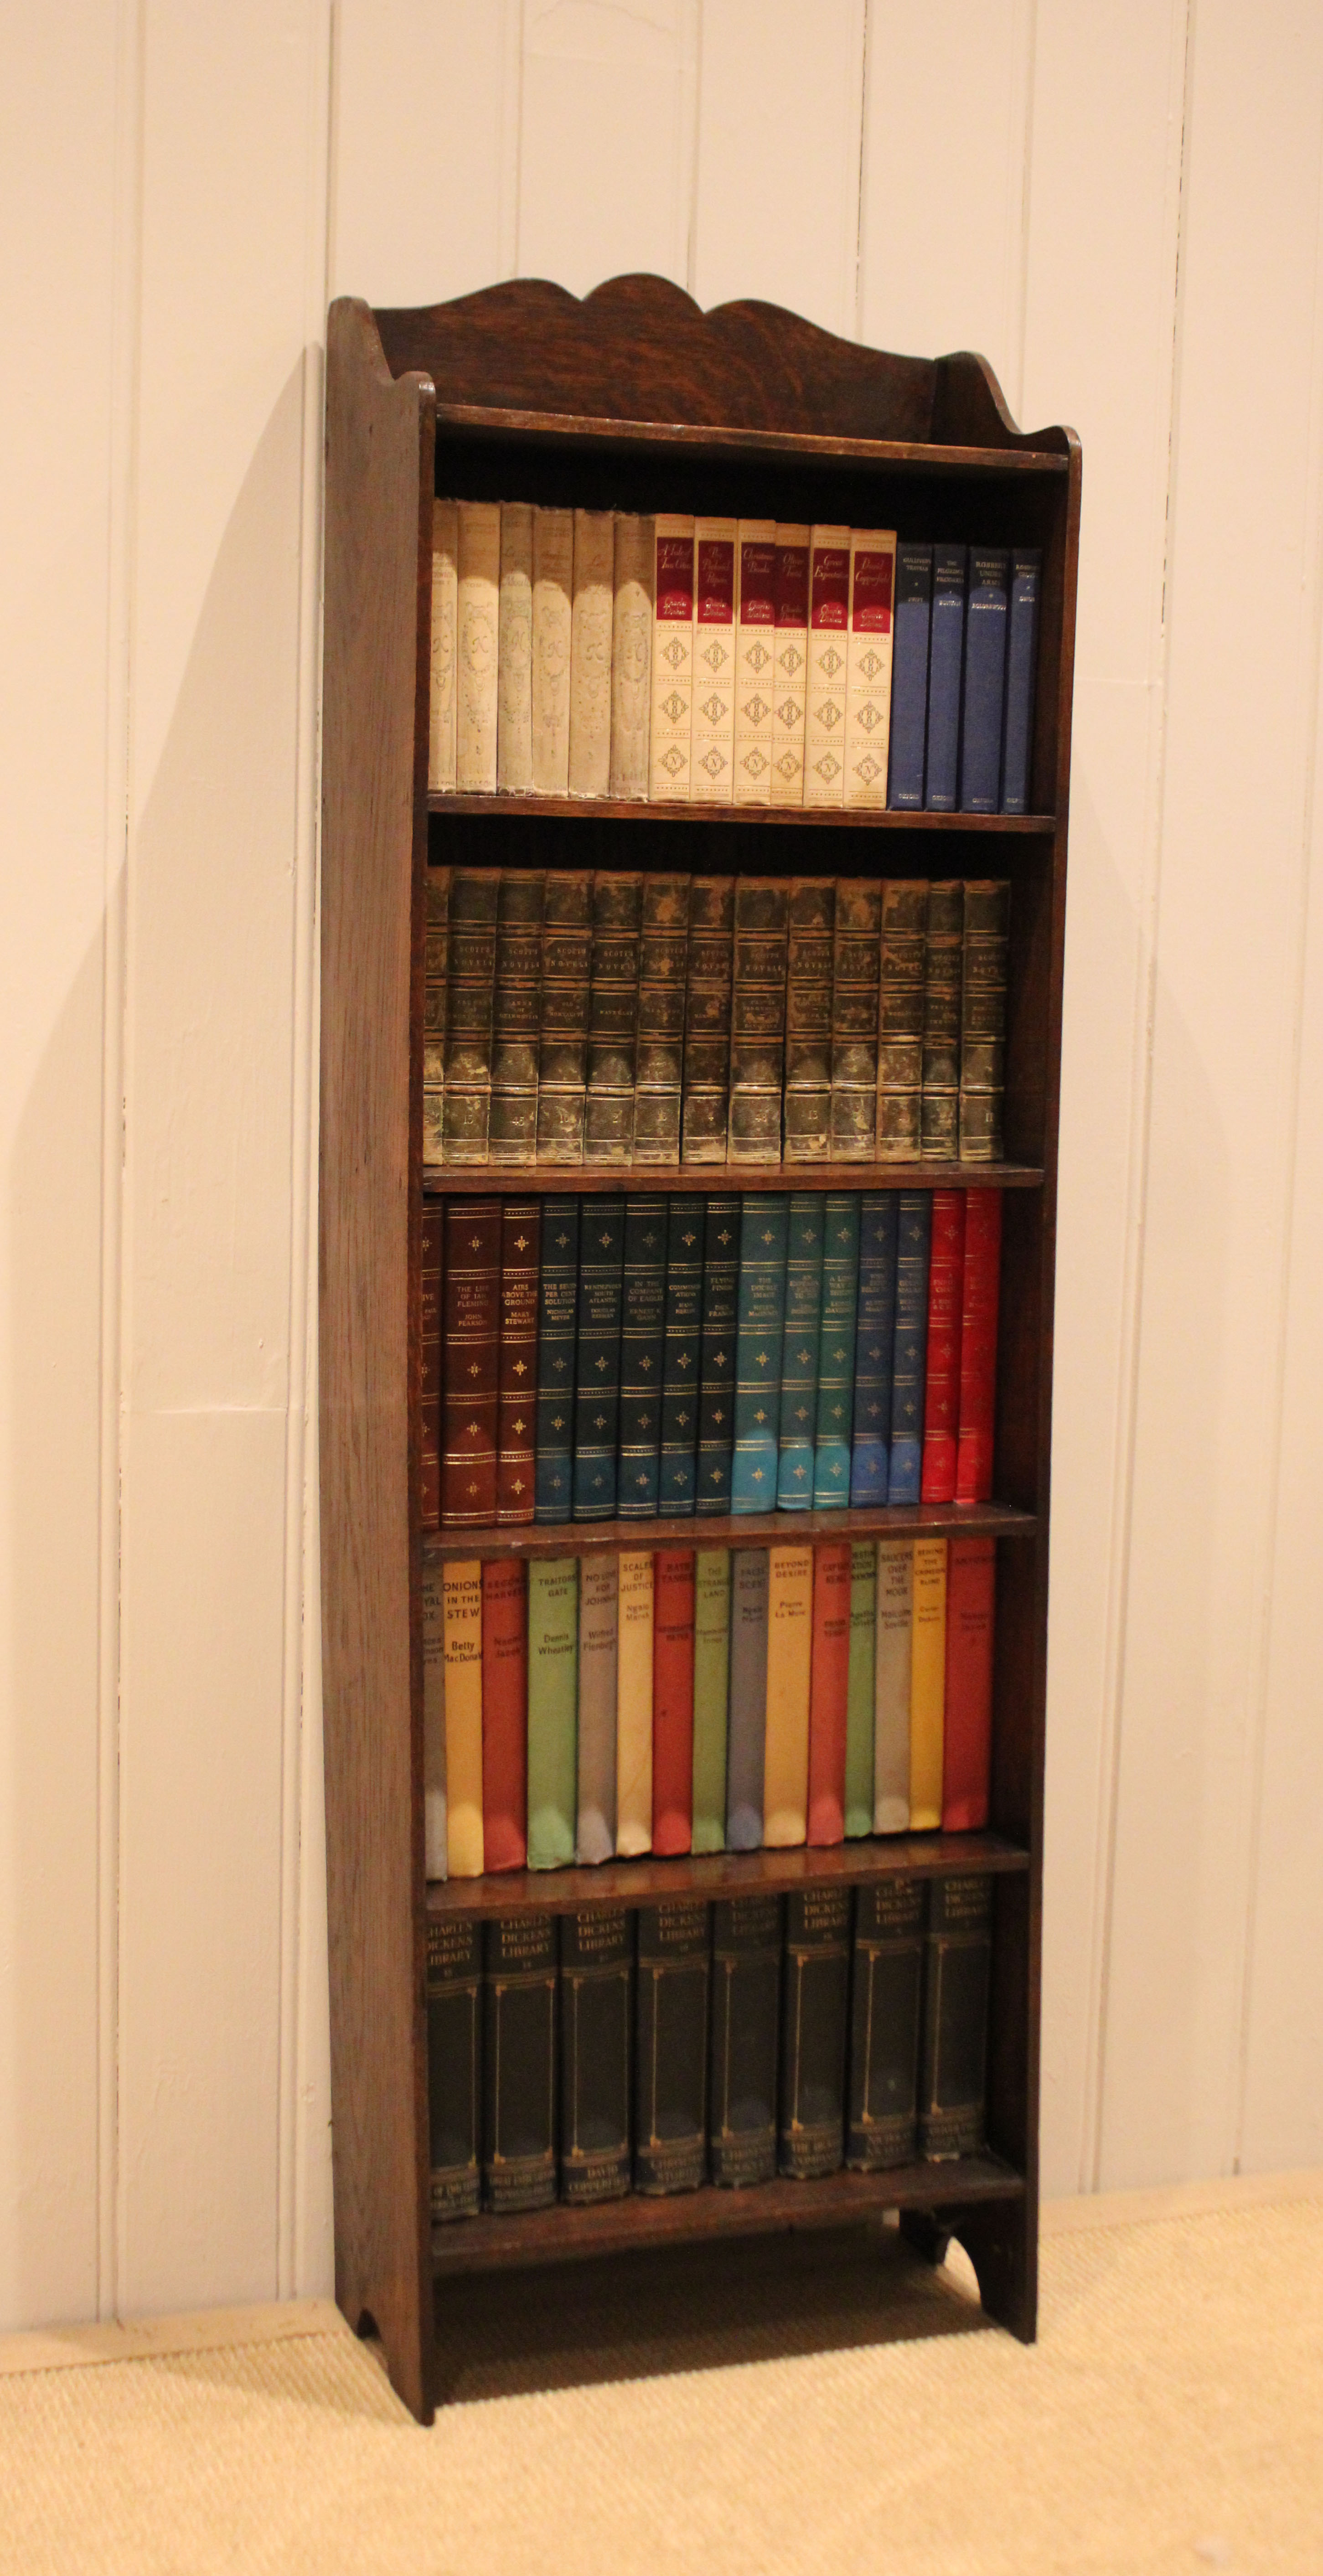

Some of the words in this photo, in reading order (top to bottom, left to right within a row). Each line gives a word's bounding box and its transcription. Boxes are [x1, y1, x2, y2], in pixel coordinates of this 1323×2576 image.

[775, 1559, 809, 1569] BEYOND
[586, 1573, 599, 1582] NO
[775, 1569, 807, 1579] DESIRE
[548, 1586, 568, 1597] GATE
[621, 1582, 653, 1592] JUSTICE
[447, 1608, 480, 1619] STEW
[544, 1633, 569, 1643] Dennis
[452, 1641, 475, 1652] Betty
[538, 1644, 573, 1655] Wheatley
[578, 1920, 626, 1937] DICKENS
[502, 1928, 551, 1944] DICKENS
[579, 1935, 624, 1952] LIBRARY
[502, 1942, 550, 1958] LIBRARY
